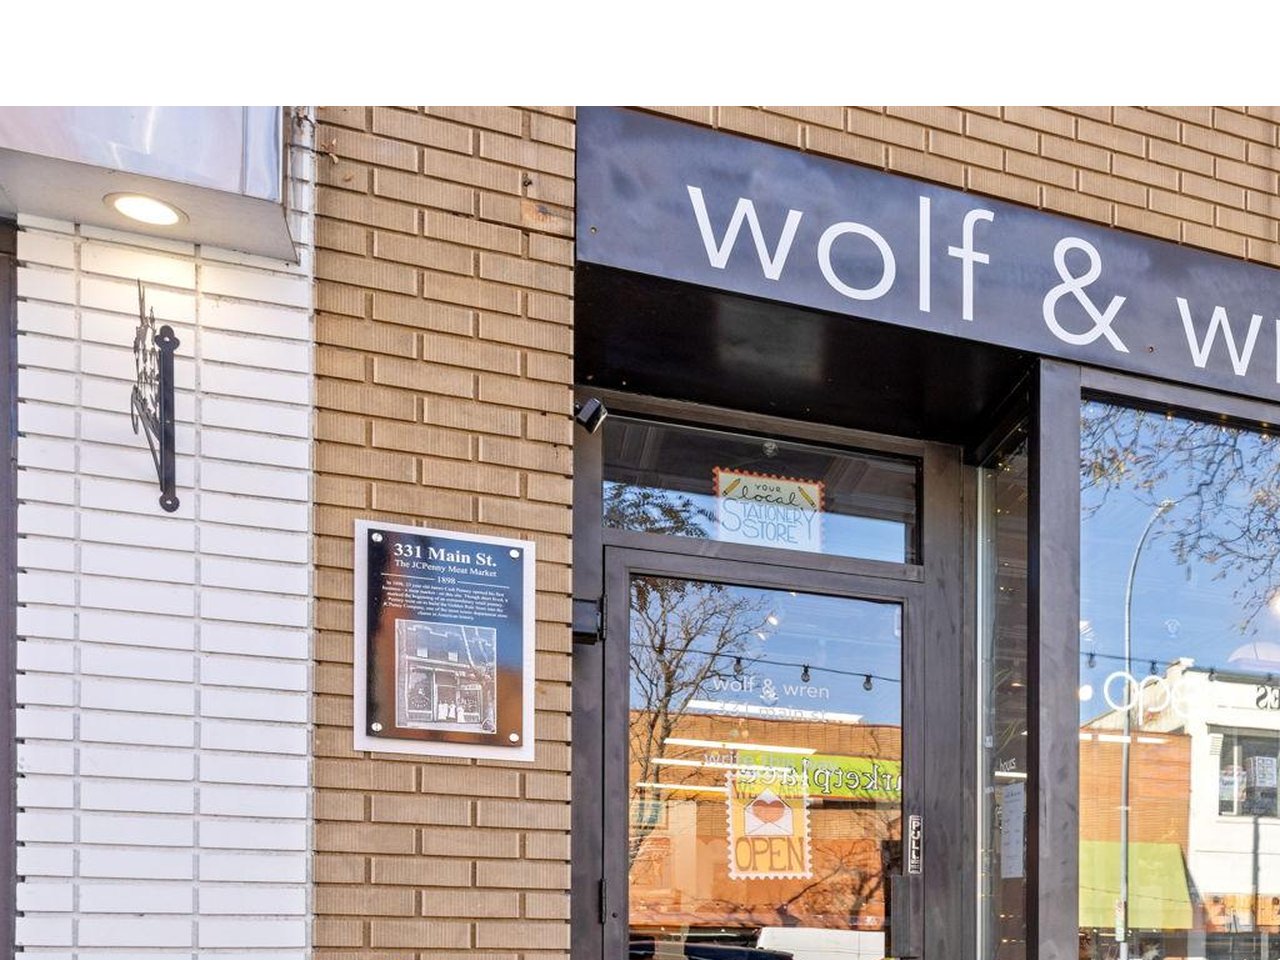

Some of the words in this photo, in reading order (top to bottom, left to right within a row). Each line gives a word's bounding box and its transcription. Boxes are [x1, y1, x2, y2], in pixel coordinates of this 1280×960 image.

[686, 184, 995, 322] wolf
[1042, 236, 1130, 353] &
[393, 543, 422, 559] 331
[428, 546, 471, 564] Main
[475, 552, 497, 567] St.
[713, 676, 755, 693] wolf
[783, 683, 830, 699] wren
[735, 836, 805, 872] OPEN
